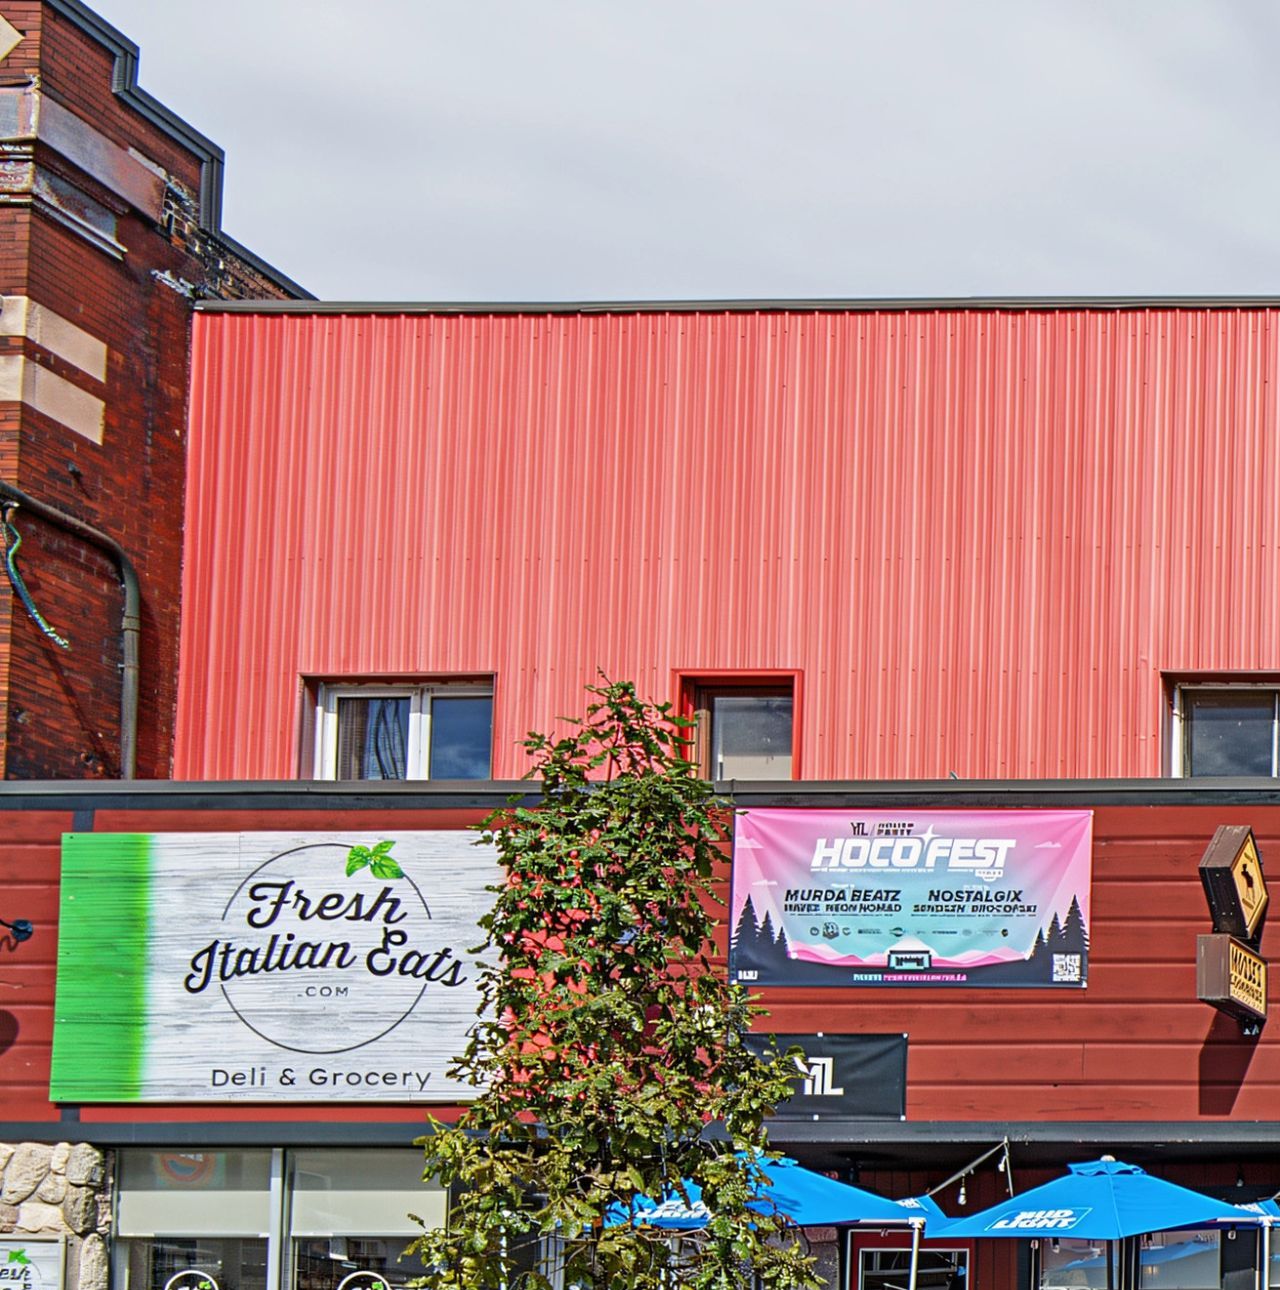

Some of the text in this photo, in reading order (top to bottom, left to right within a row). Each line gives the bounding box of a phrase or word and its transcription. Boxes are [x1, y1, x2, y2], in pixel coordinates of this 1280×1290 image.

[247, 880, 409, 930] Fresh
[784, 889, 902, 902] MURDA BEATZ
[928, 889, 1023, 902] NOSTALGIX
[183, 926, 468, 994] Italian Eats
[211, 1067, 432, 1092] Deli & Grocery
